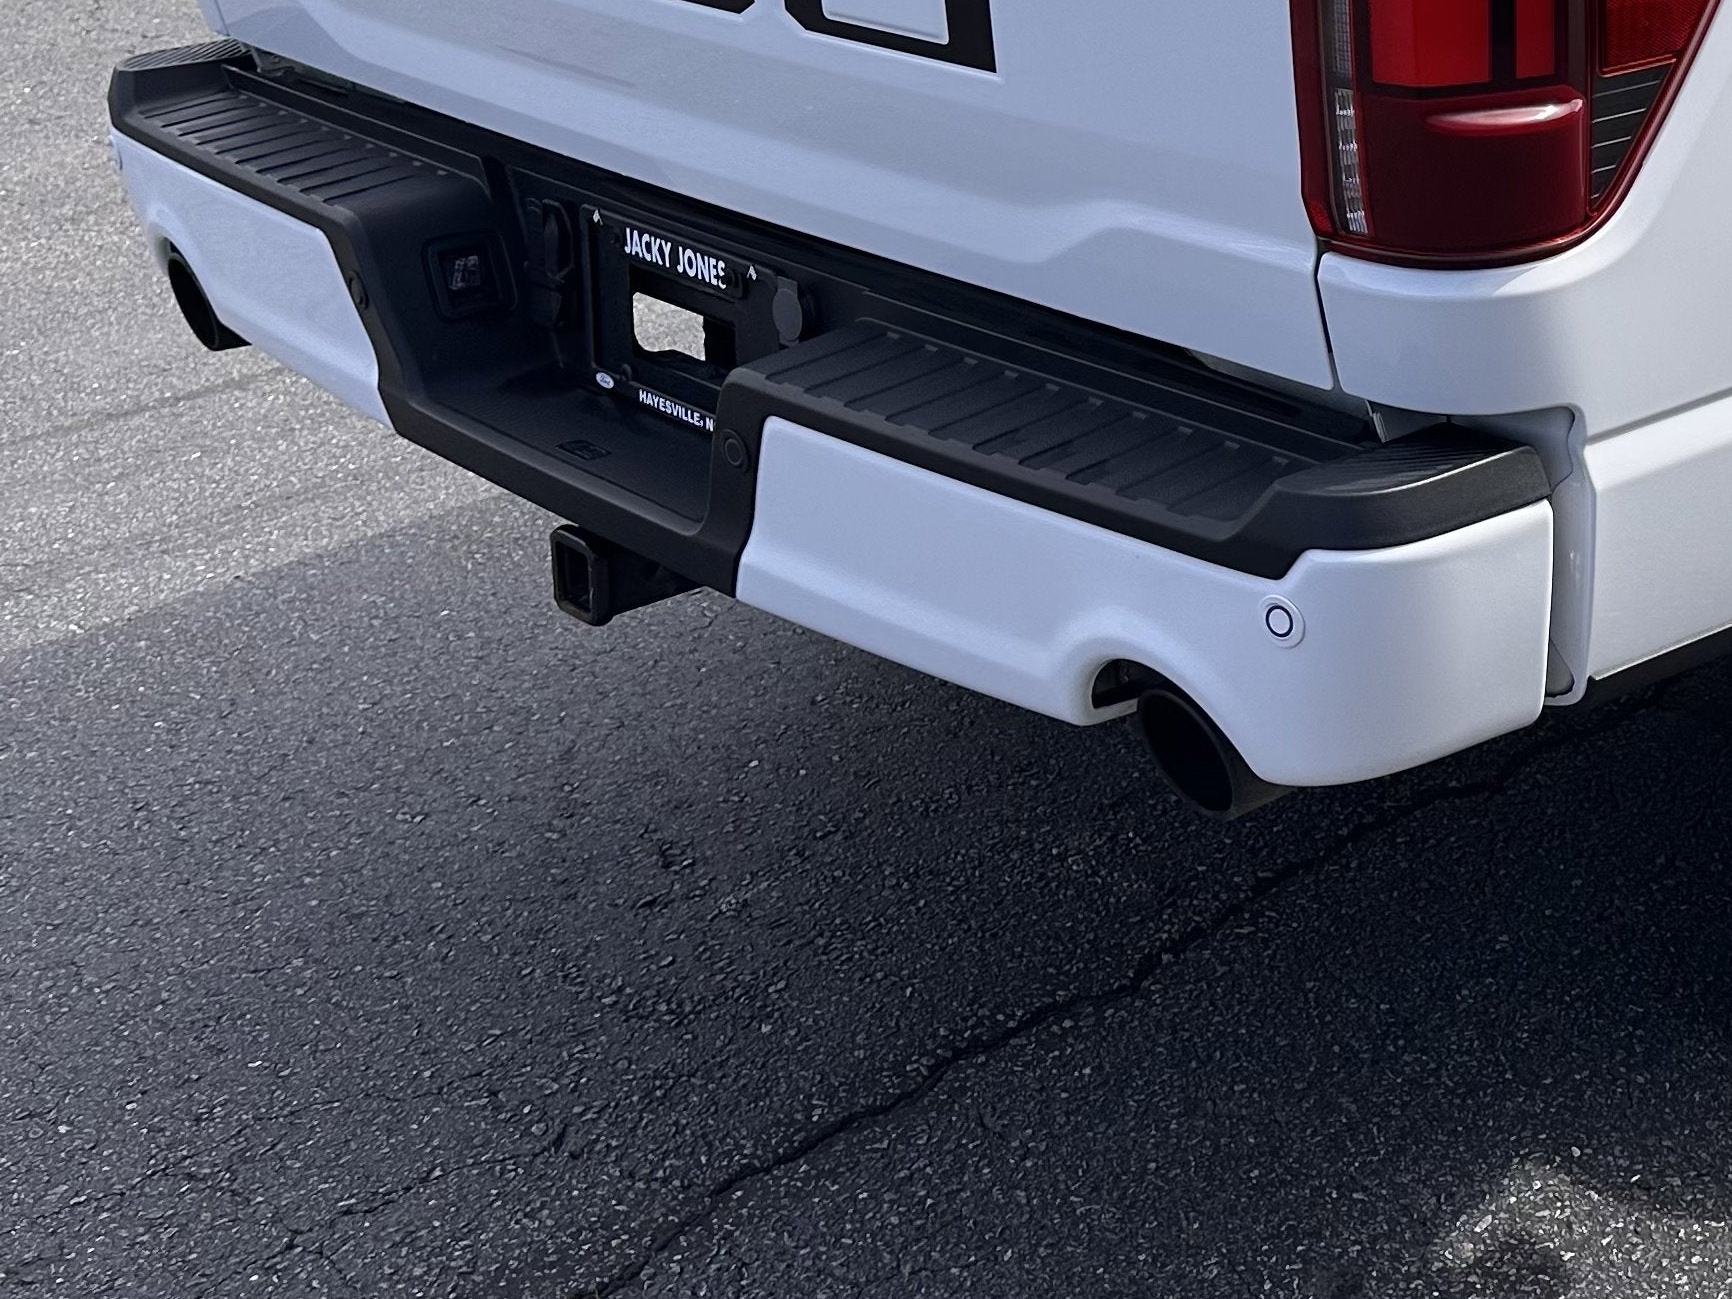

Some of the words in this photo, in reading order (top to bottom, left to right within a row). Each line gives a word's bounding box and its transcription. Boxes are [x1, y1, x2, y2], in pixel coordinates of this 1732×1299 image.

[623, 227, 672, 269] JACKY
[676, 245, 727, 290] JONES
[638, 388, 704, 428] HAYESVILLE,
[705, 415, 716, 433] N
